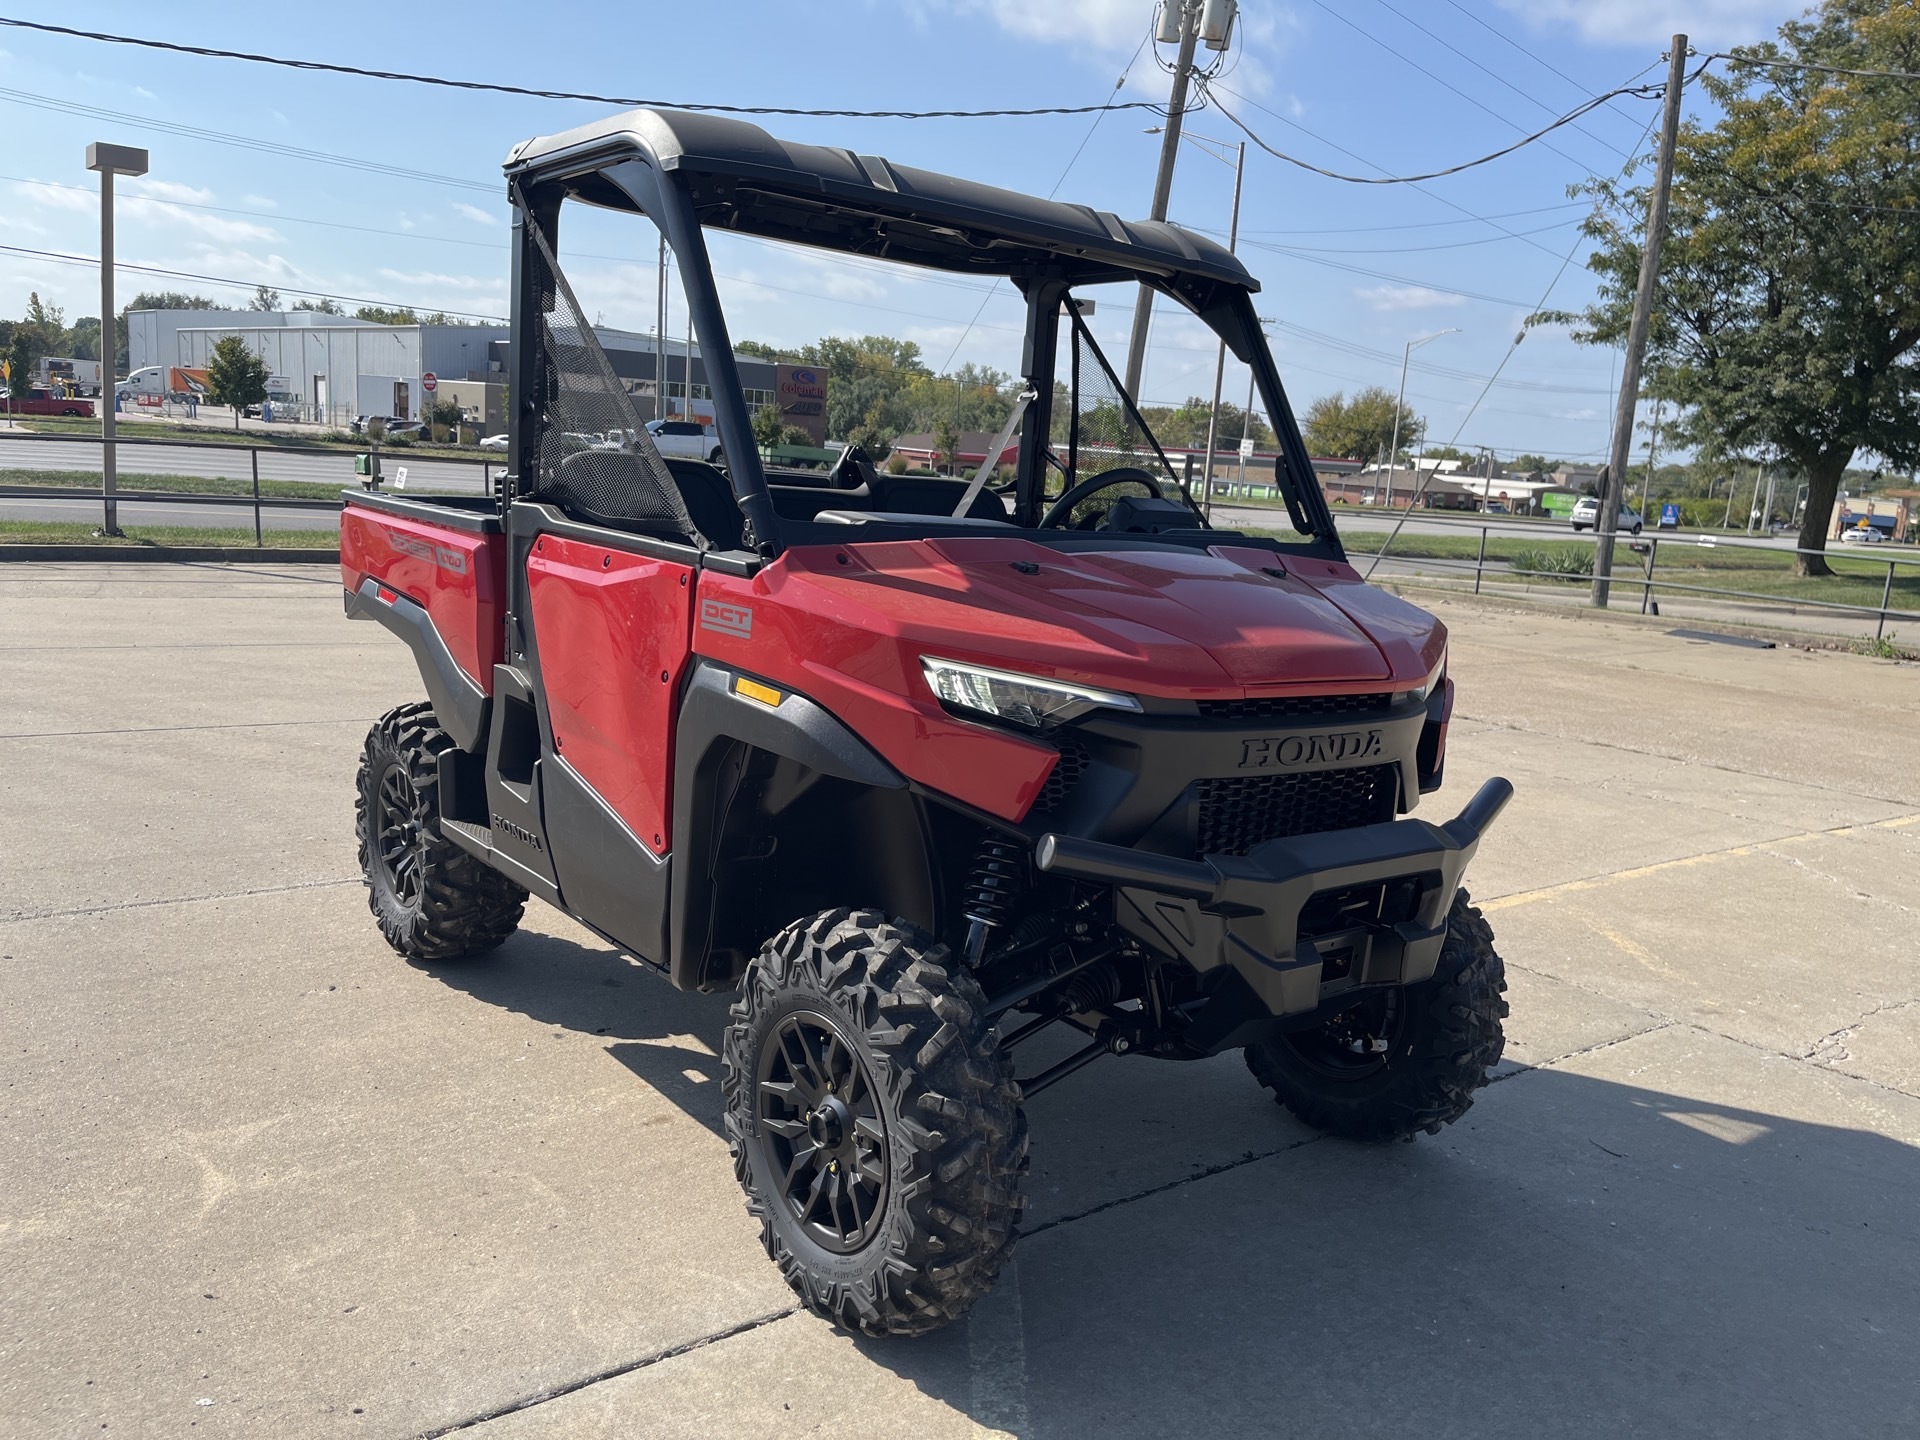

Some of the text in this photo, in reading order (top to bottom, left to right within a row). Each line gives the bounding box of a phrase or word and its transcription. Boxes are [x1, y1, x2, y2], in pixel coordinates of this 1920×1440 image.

[782, 383, 823, 396] Coleman
[440, 552, 462, 568] 1000
[705, 604, 749, 625] DCT
[1238, 730, 1383, 768] HONDA
[492, 813, 543, 852] HONDA
